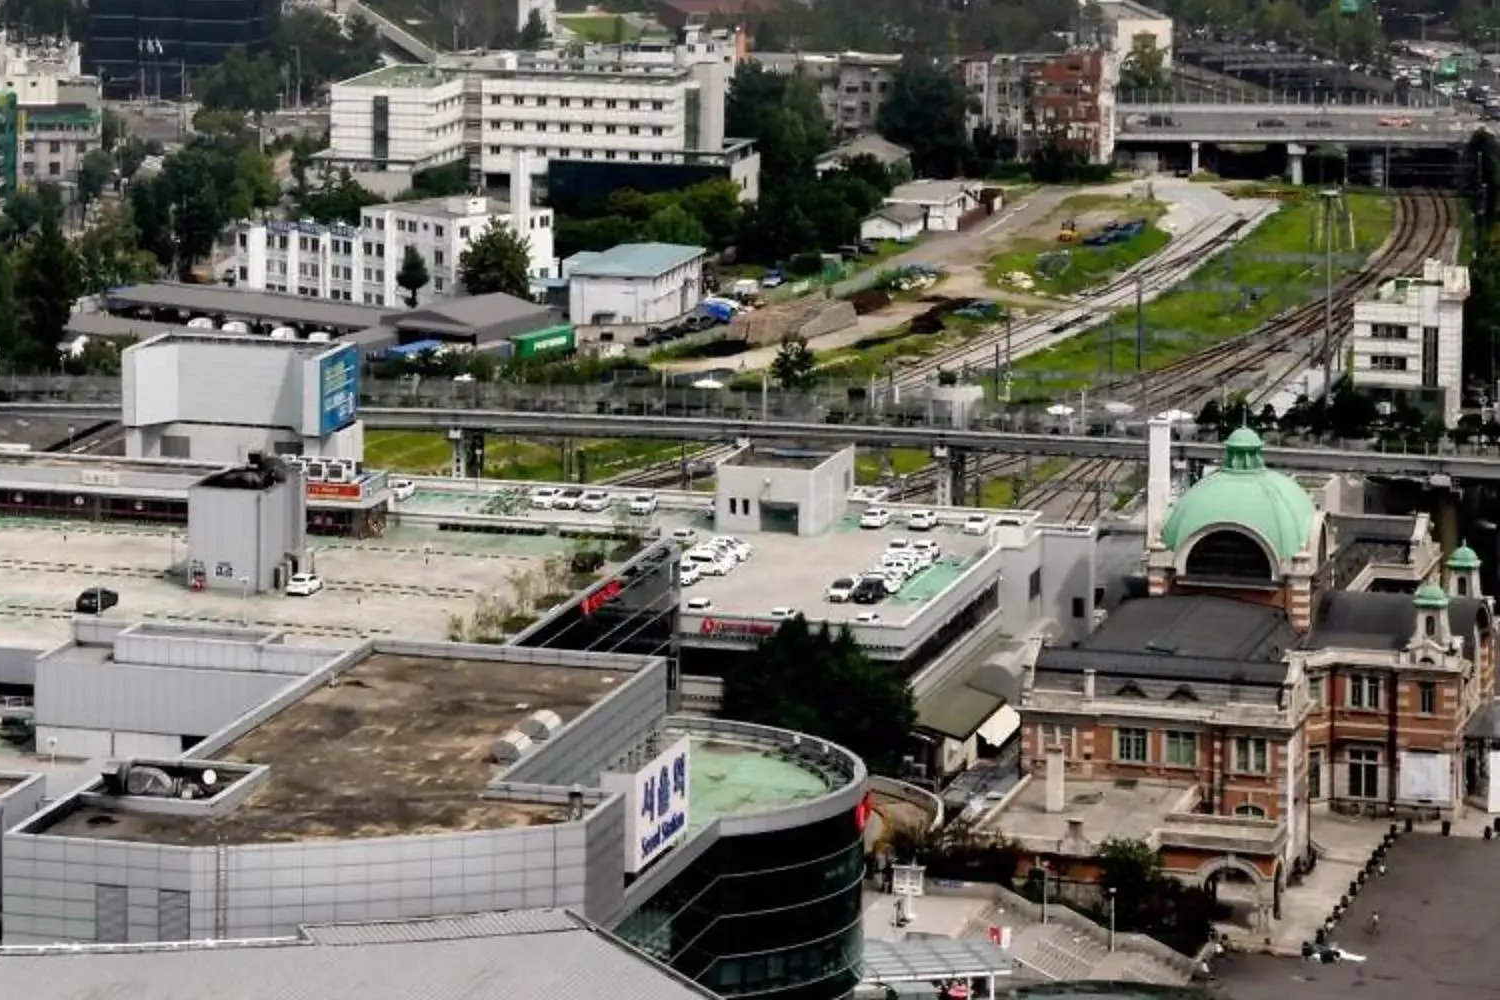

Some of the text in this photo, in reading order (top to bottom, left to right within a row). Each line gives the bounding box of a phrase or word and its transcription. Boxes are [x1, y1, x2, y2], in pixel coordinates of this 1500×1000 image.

[641, 752, 685, 824] 서울역
[641, 812, 685, 859] Seoul Station
